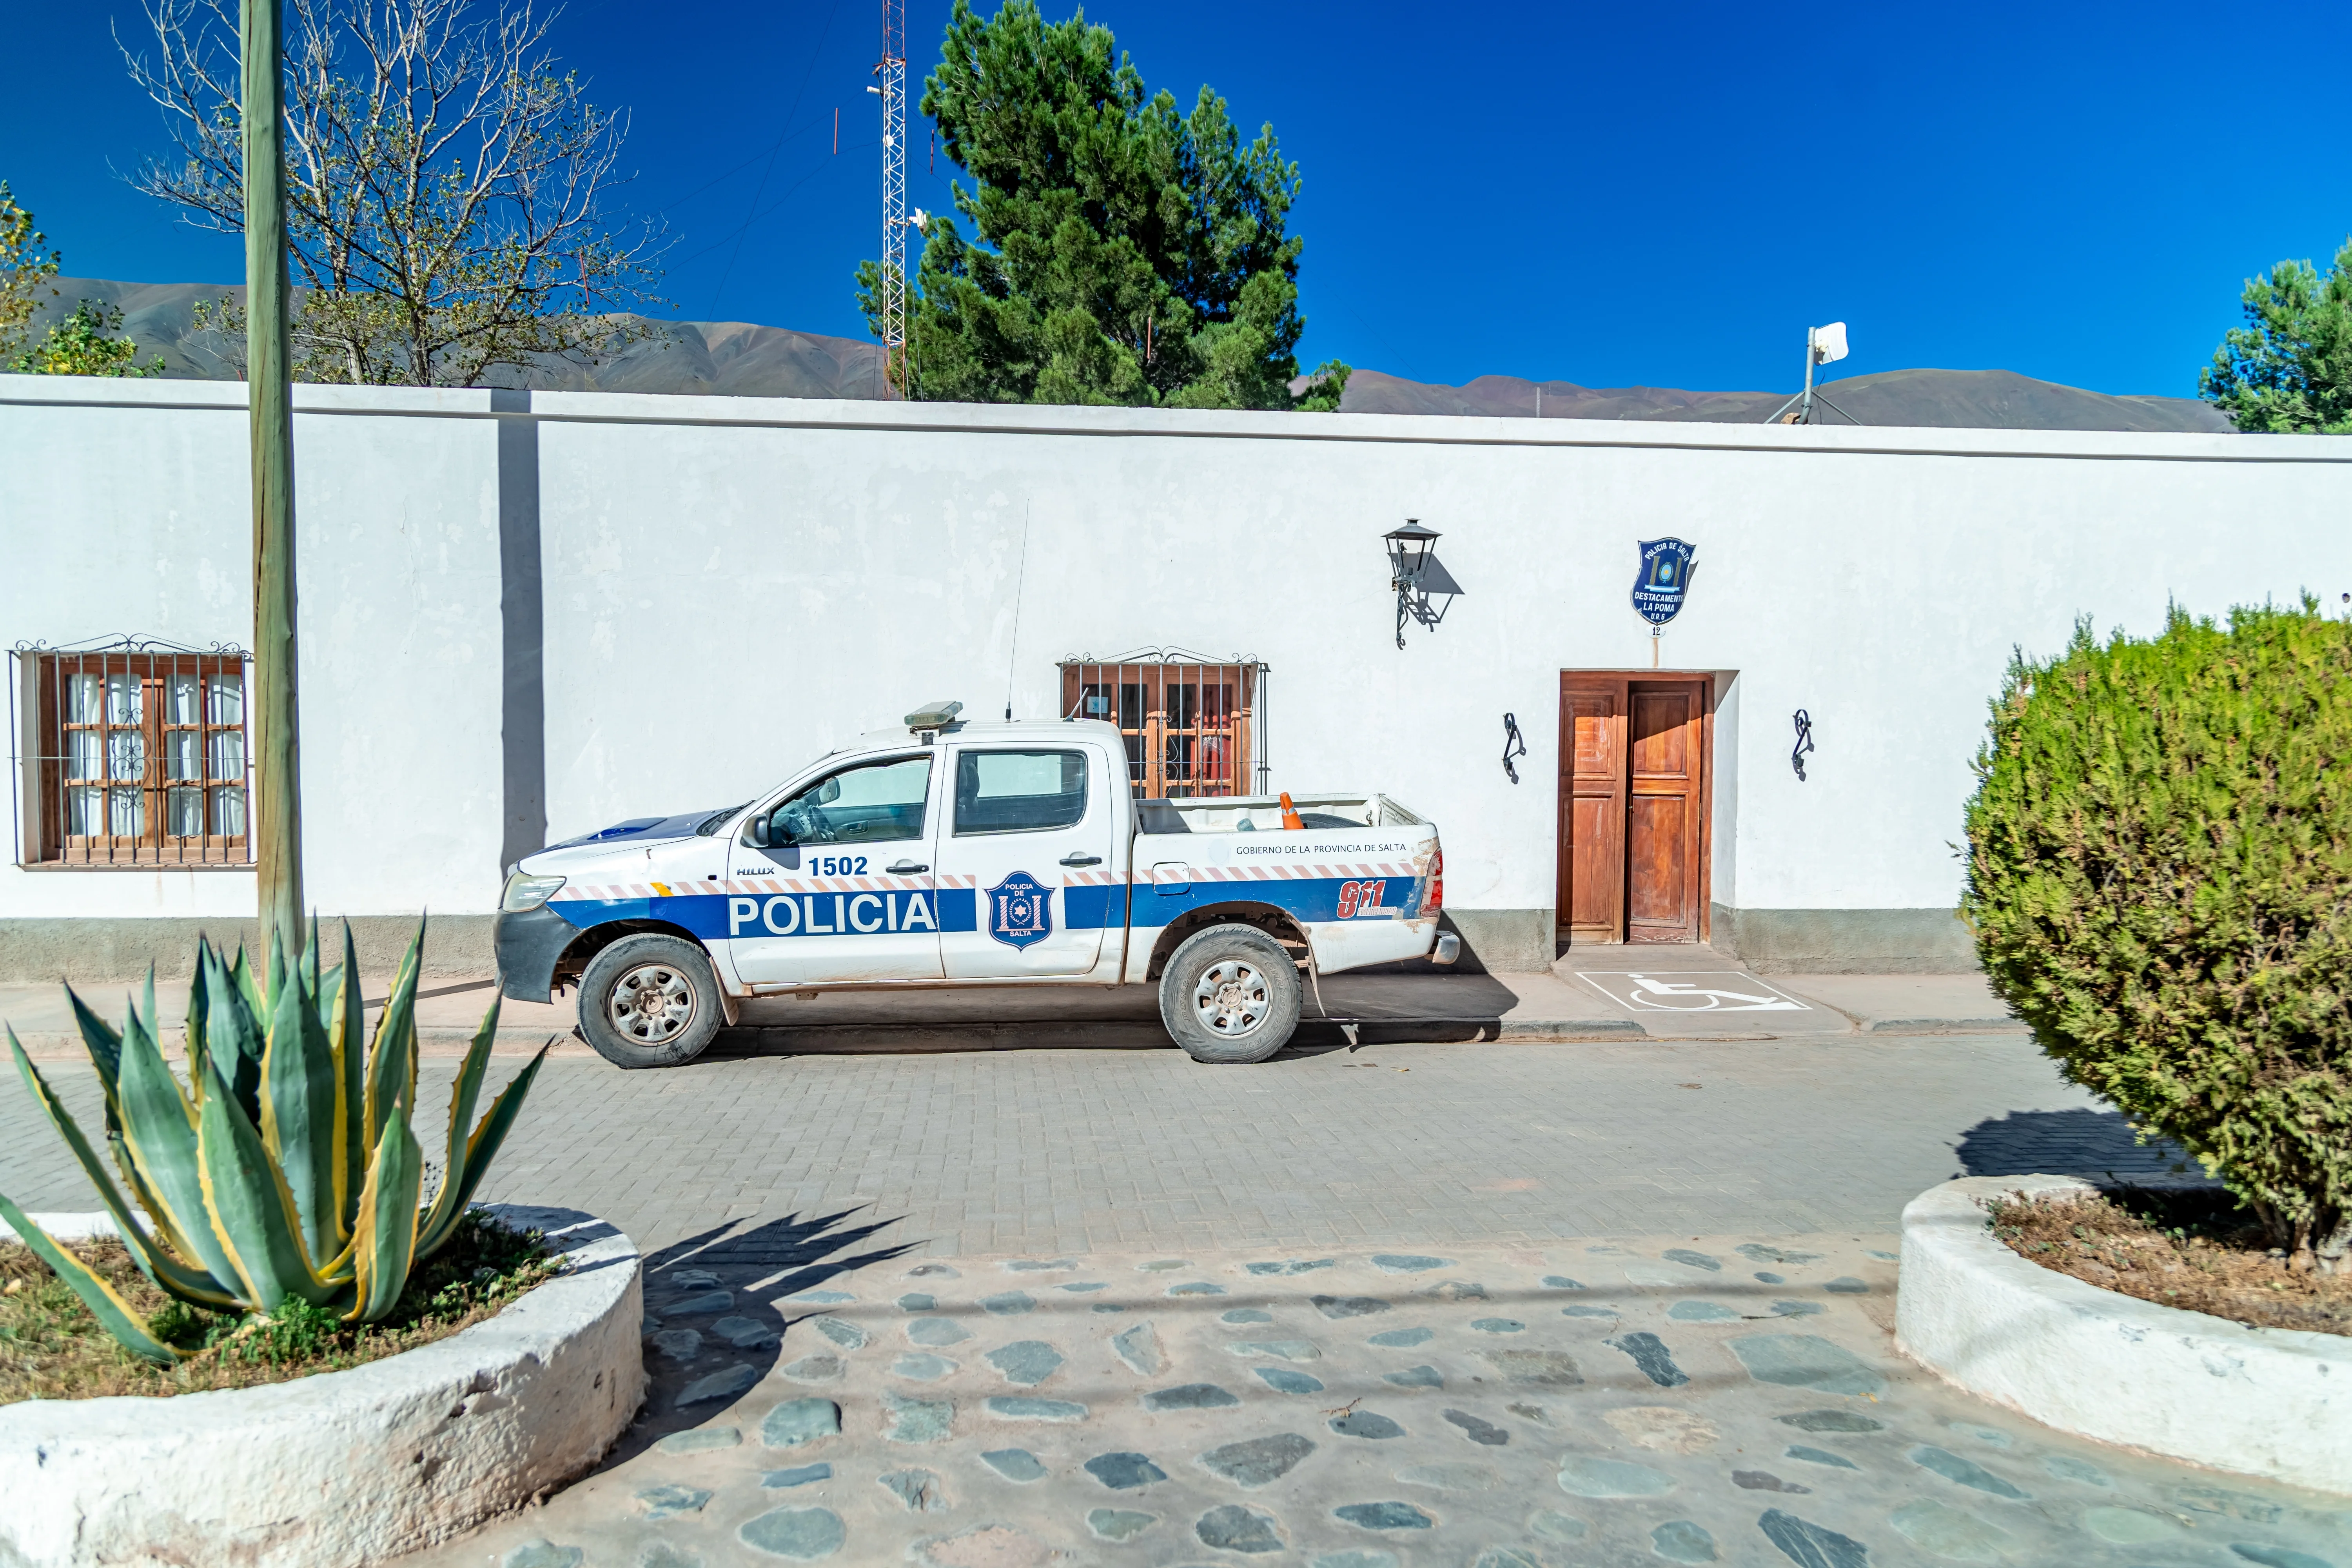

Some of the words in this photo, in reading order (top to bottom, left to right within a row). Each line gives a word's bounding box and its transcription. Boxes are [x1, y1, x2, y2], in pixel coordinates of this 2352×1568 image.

[1645, 543, 1667, 560] POLICIA
[1677, 545, 1690, 562] SALTA
[1635, 592, 1684, 602] DESTACAMENTO
[1643, 602, 1653, 611] LA
[1654, 603, 1674, 612] POMA
[1653, 626, 1661, 635] 12
[737, 867, 775, 875] HILUX
[809, 857, 867, 876] 1502
[1337, 880, 1386, 918] 911
[729, 893, 937, 935] POLICIA
[1180, 960, 1201, 1021] DUNLOP
